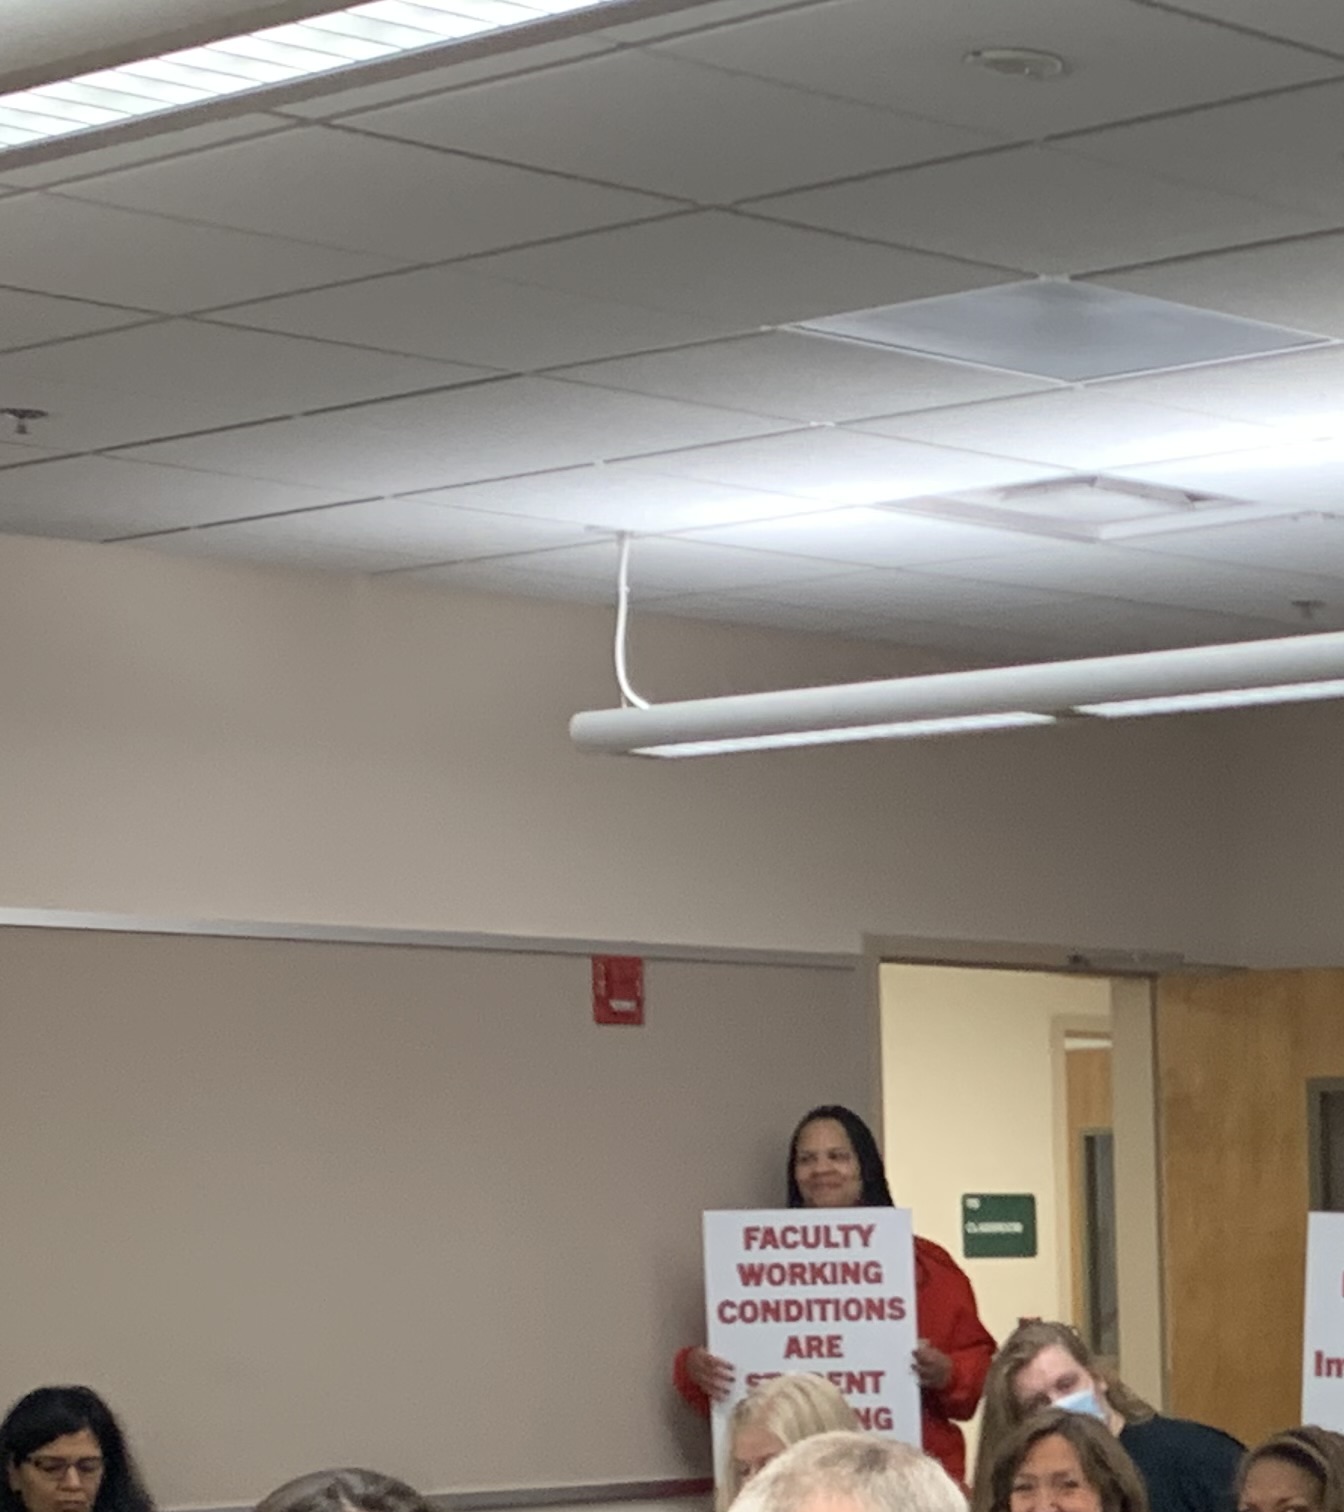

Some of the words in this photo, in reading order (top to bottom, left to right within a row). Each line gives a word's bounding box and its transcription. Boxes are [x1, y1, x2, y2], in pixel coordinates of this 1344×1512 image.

[743, 1224, 875, 1251] FACULTY
[737, 1261, 883, 1287] WORKING
[717, 1297, 906, 1324] CONDITIONS
[784, 1335, 843, 1359] ARE
